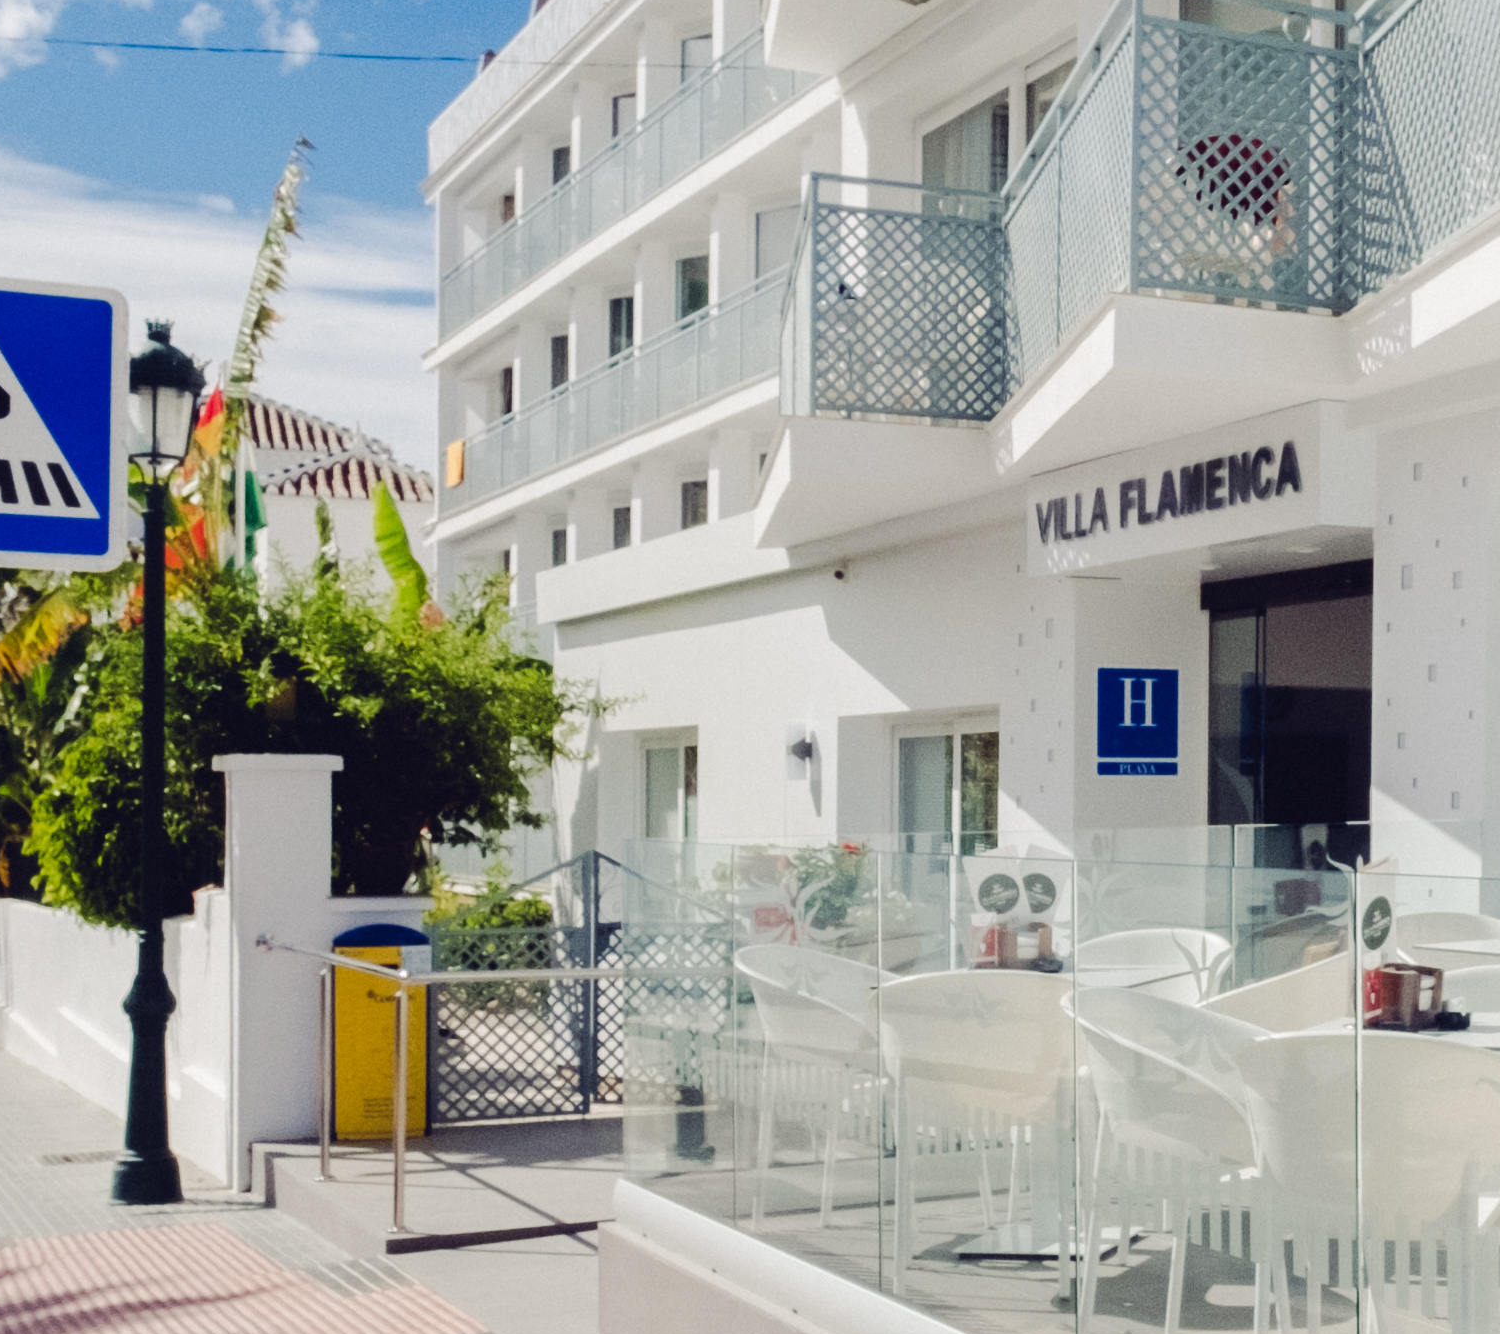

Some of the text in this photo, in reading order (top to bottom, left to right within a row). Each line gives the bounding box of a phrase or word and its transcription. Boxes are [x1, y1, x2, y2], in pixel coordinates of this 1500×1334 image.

[1035, 440, 1303, 544] VILLA FLAMENCA
[1119, 677, 1158, 727] H
[1119, 763, 1157, 774] PLAYA
